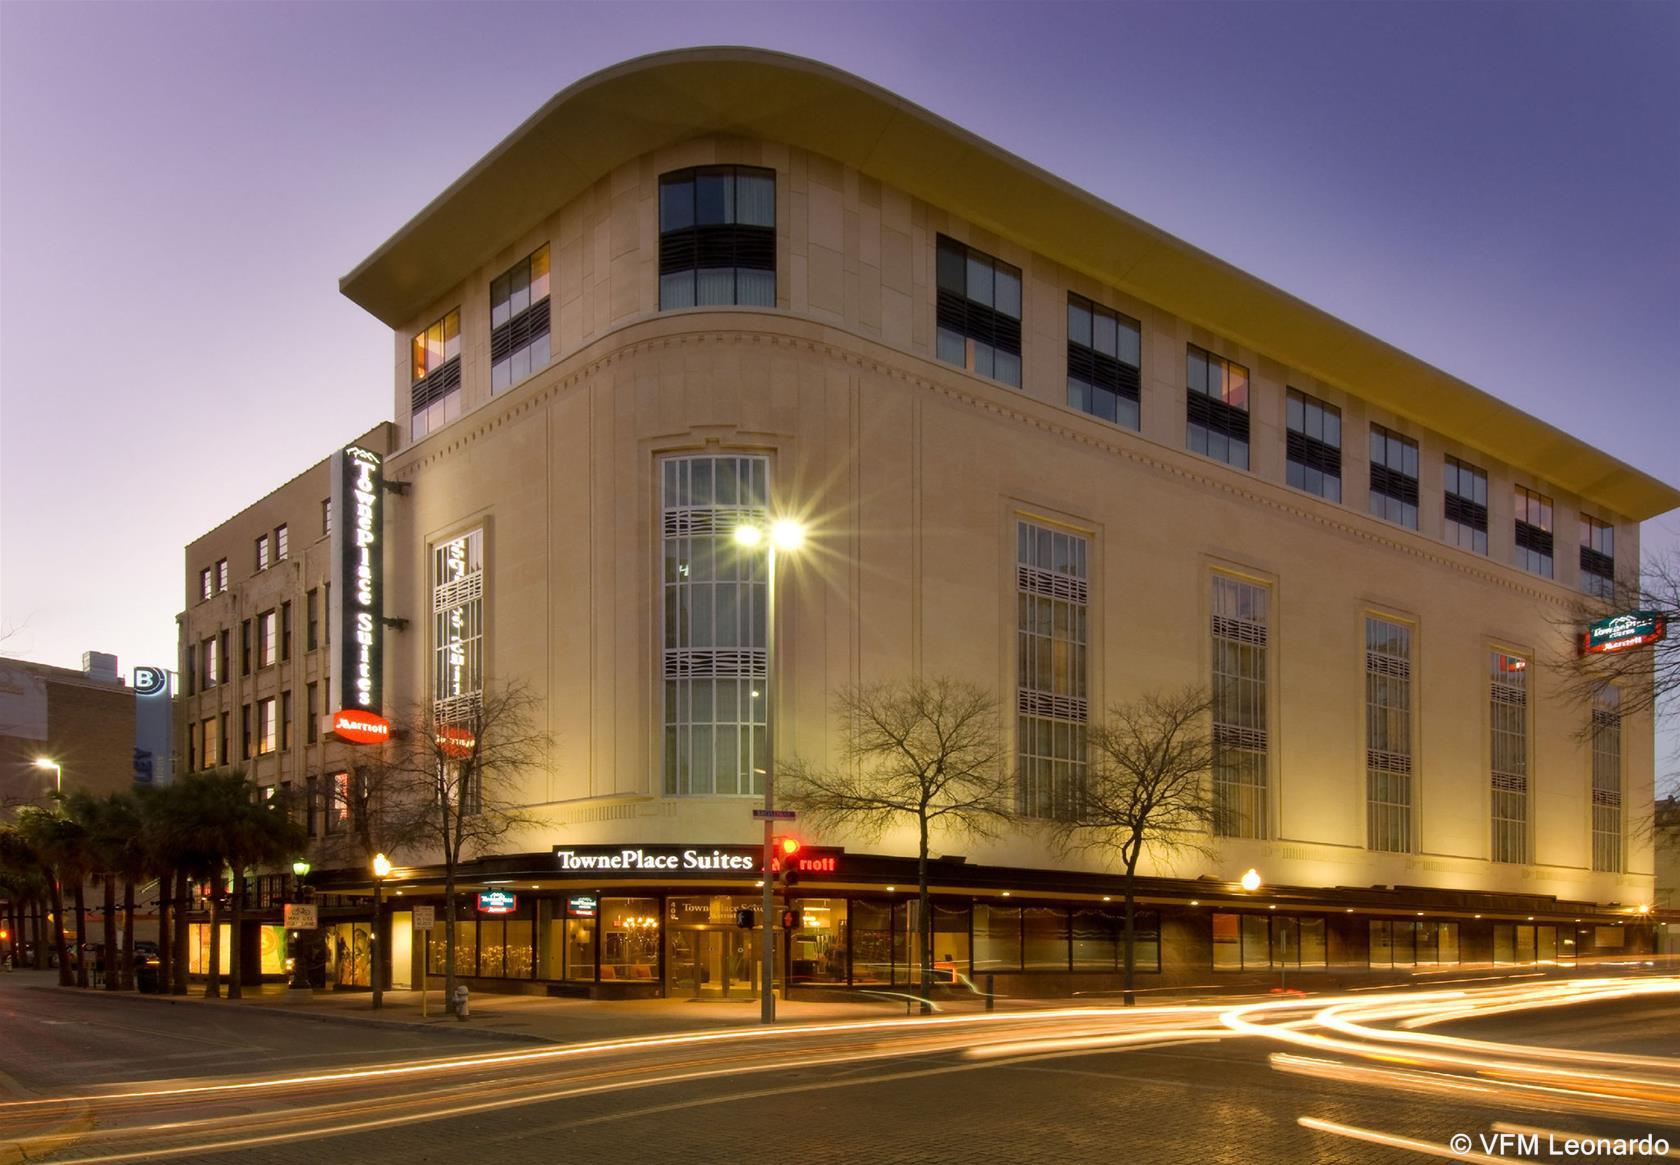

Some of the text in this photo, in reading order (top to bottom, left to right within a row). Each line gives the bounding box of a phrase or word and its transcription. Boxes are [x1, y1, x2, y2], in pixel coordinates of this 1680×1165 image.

[353, 458, 377, 705] TownePlace Suites
[335, 717, 388, 735] Marriott
[558, 850, 678, 870] TownePlace
[683, 850, 753, 870] Suites
